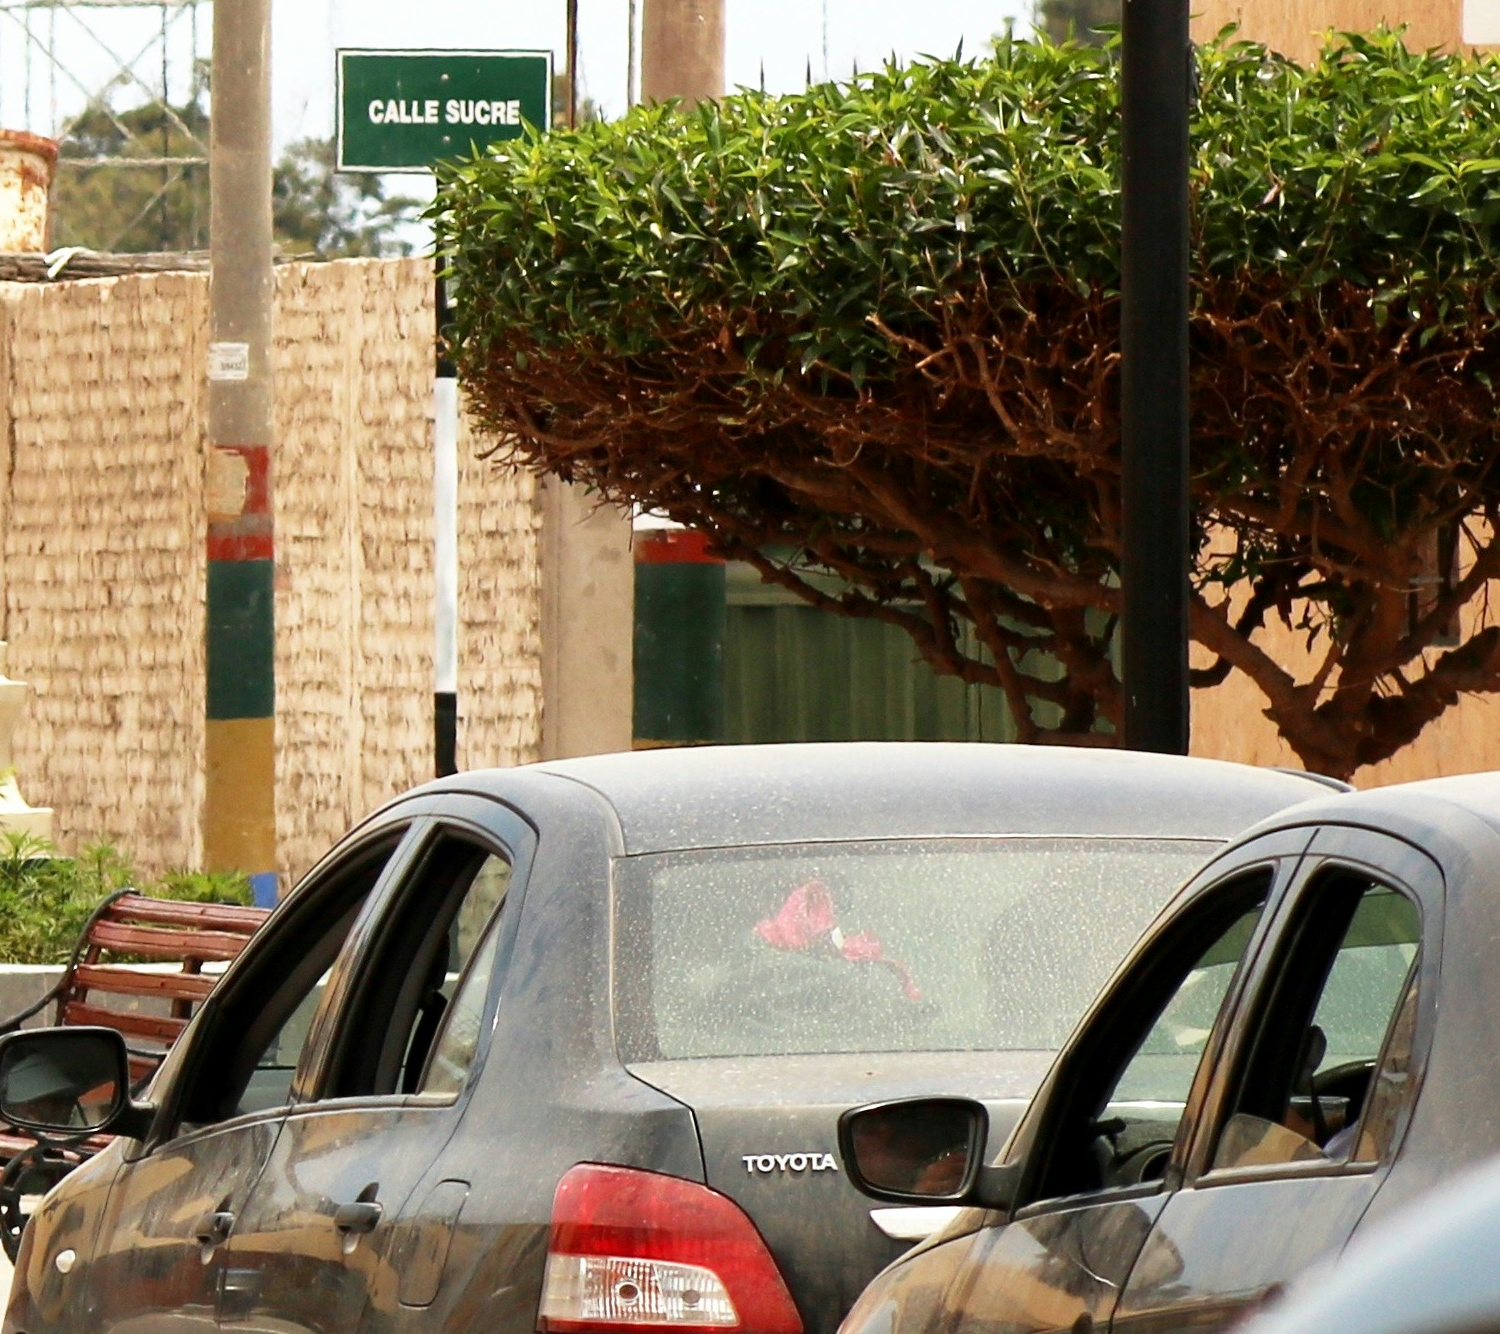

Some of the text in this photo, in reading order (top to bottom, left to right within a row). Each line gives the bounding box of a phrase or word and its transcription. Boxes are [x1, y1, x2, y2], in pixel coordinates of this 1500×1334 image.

[368, 99, 520, 125] CALLE SUCRE
[742, 1153, 839, 1173] TOYOTA
